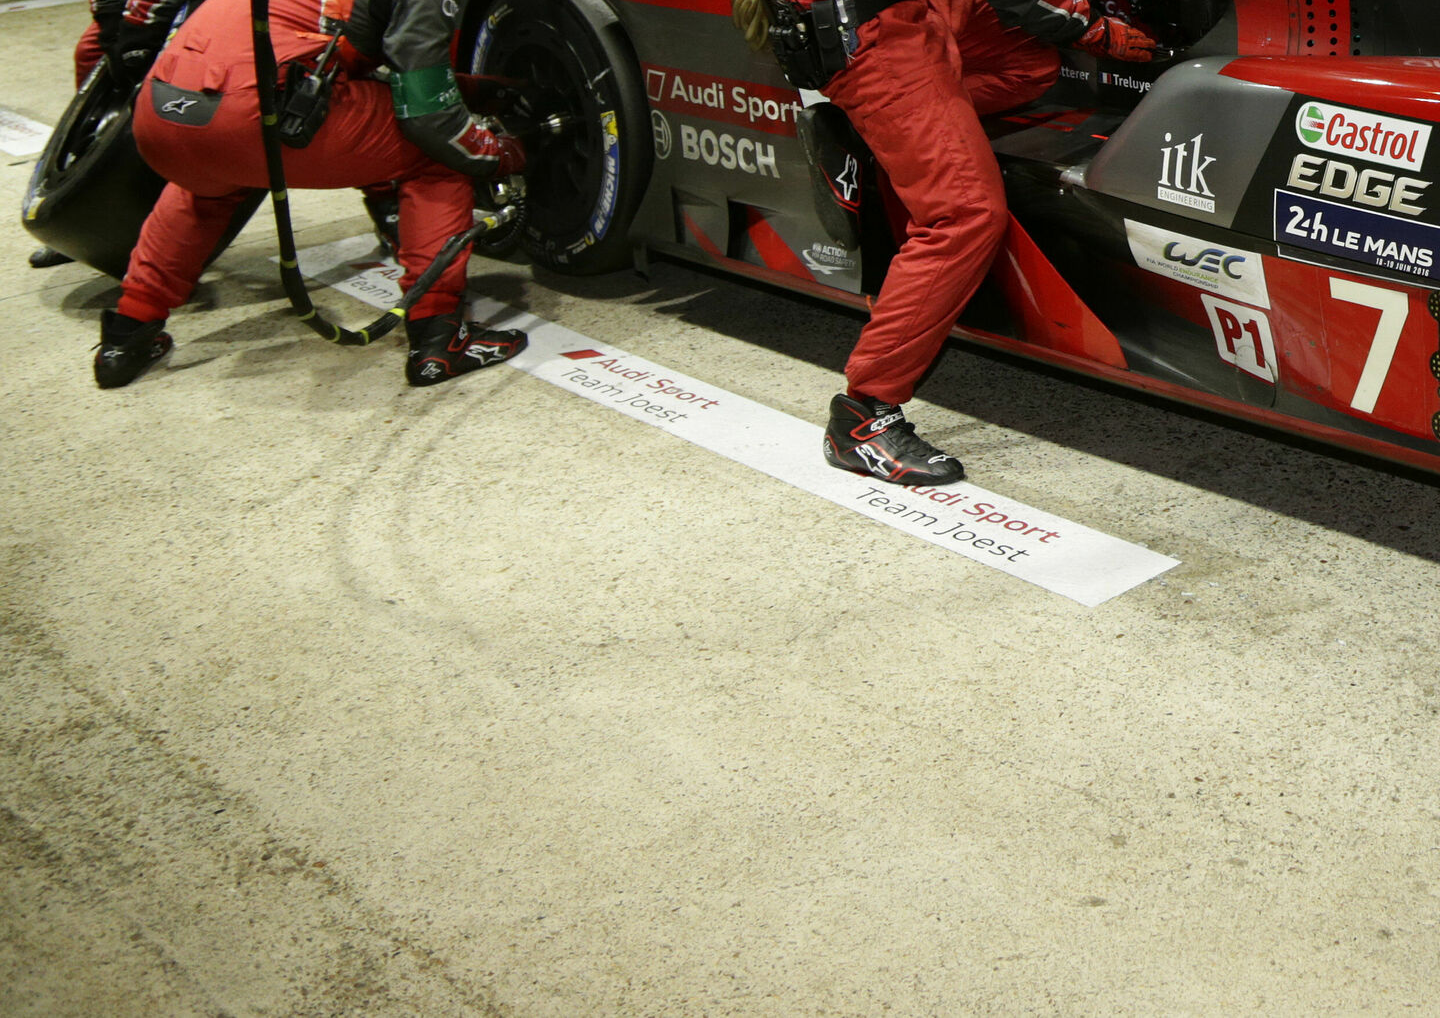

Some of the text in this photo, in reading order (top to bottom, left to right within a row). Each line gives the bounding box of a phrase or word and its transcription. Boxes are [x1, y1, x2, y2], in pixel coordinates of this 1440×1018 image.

[670, 75, 803, 123] Audi Sport
[1113, 73, 1153, 94] Treluye
[680, 124, 781, 179] BOSCH
[1326, 113, 1419, 163] Castrol
[1158, 132, 1216, 197] itk
[1286, 153, 1433, 216] EDGE
[1159, 189, 1214, 210] ENGINEERING
[822, 245, 847, 258] ACTION
[1163, 241, 1246, 280] WEC
[1285, 206, 1433, 267] 24h LE MANS
[350, 274, 393, 302] Team
[1157, 261, 1179, 272] WORLD
[1178, 267, 1219, 283] ENDURANCE
[1172, 271, 1219, 289] CHAMPIONSHIP
[1396, 261, 1411, 273] JUIN
[1412, 264, 1430, 277] 2016
[1215, 306, 1266, 369] P1
[1329, 276, 1410, 414] 7
[561, 366, 688, 423] Team Joest
[591, 357, 720, 411] Audi Sport
[855, 486, 1031, 563] Team Joest
[962, 501, 1061, 544] Sport
